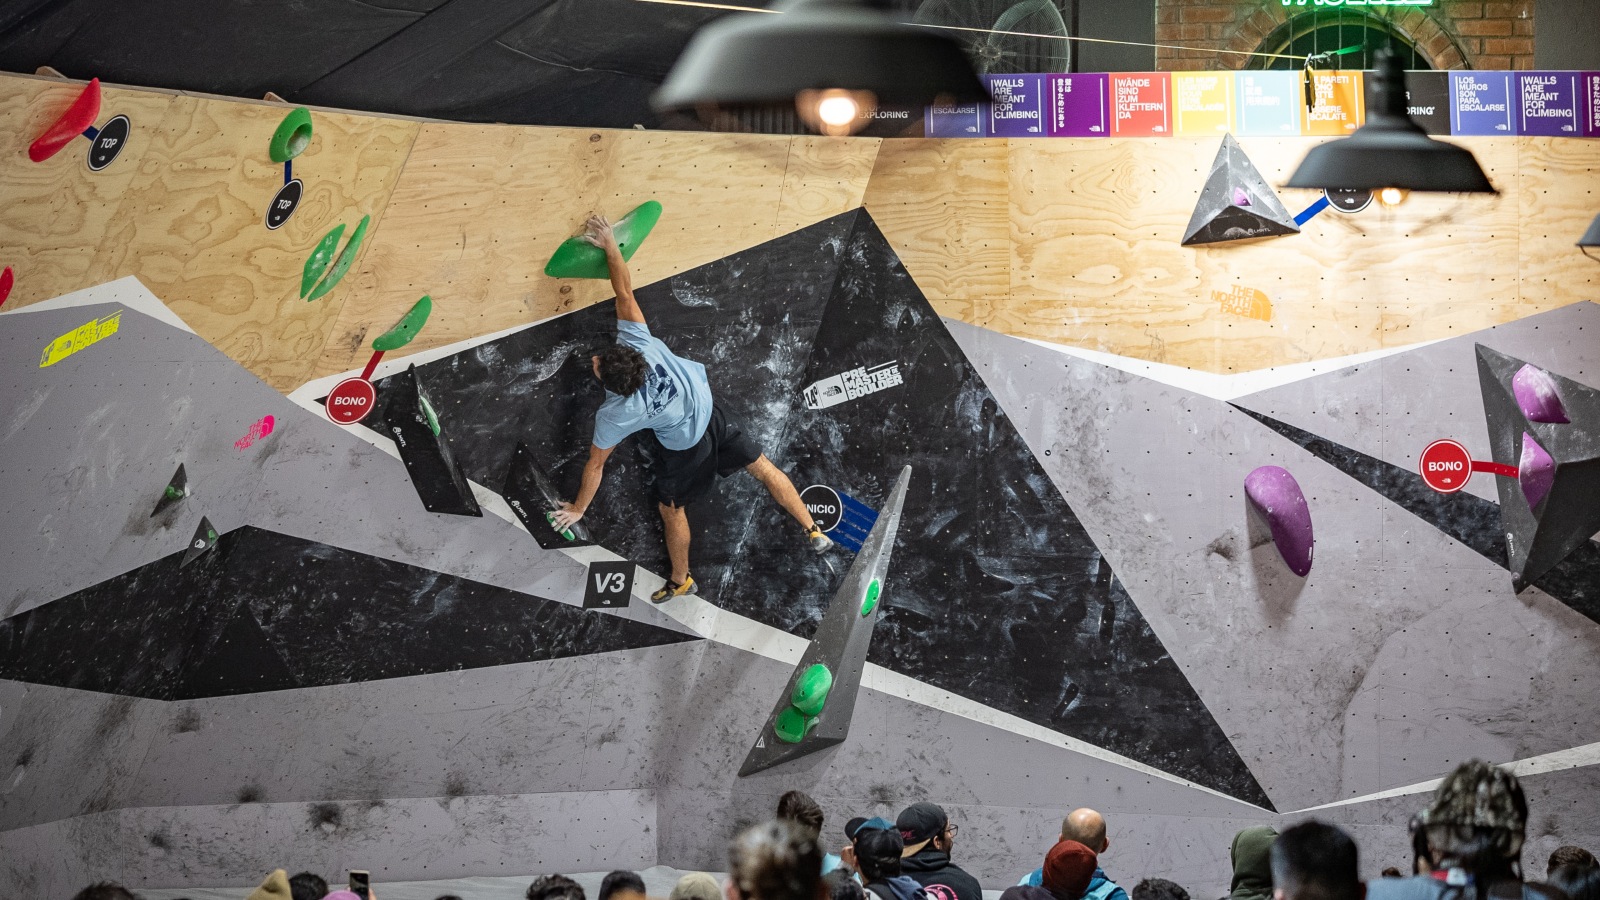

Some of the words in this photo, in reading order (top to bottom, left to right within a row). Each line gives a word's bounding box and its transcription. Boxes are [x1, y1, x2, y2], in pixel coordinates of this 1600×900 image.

[994, 79, 1024, 87] WALLS
[1118, 77, 1150, 87] WÄNDE
[1320, 76, 1349, 84] PARETI
[1524, 76, 1557, 85] WALLS
[994, 87, 1012, 95] ARE
[1118, 87, 1139, 95] SIND
[1459, 83, 1488, 91] MUROS
[1459, 90, 1476, 98] SON
[1525, 93, 1559, 101] MEANT
[994, 95, 1025, 103] MEANT
[1119, 95, 1138, 103] ZUM
[994, 103, 1013, 111] FOR
[1119, 103, 1163, 111] KLETTERN
[1525, 101, 1545, 109] FOR
[933, 107, 976, 115] ESCALARSE
[994, 111, 1038, 119] CLIMBING
[1119, 111, 1132, 119] DA
[1526, 109, 1572, 117] CLIMBING
[100, 138, 117, 149] TOP
[277, 199, 292, 210] TOP
[1230, 284, 1254, 298] THE
[1210, 290, 1252, 309] NORTH
[1220, 302, 1250, 318] FACE
[841, 366, 867, 381] PRE
[844, 368, 891, 391] MASTER
[848, 374, 904, 401] BOULDER
[334, 397, 366, 406] BONO
[1428, 461, 1463, 471] BONO
[806, 503, 836, 514] NICIO
[595, 572, 626, 594] V3
